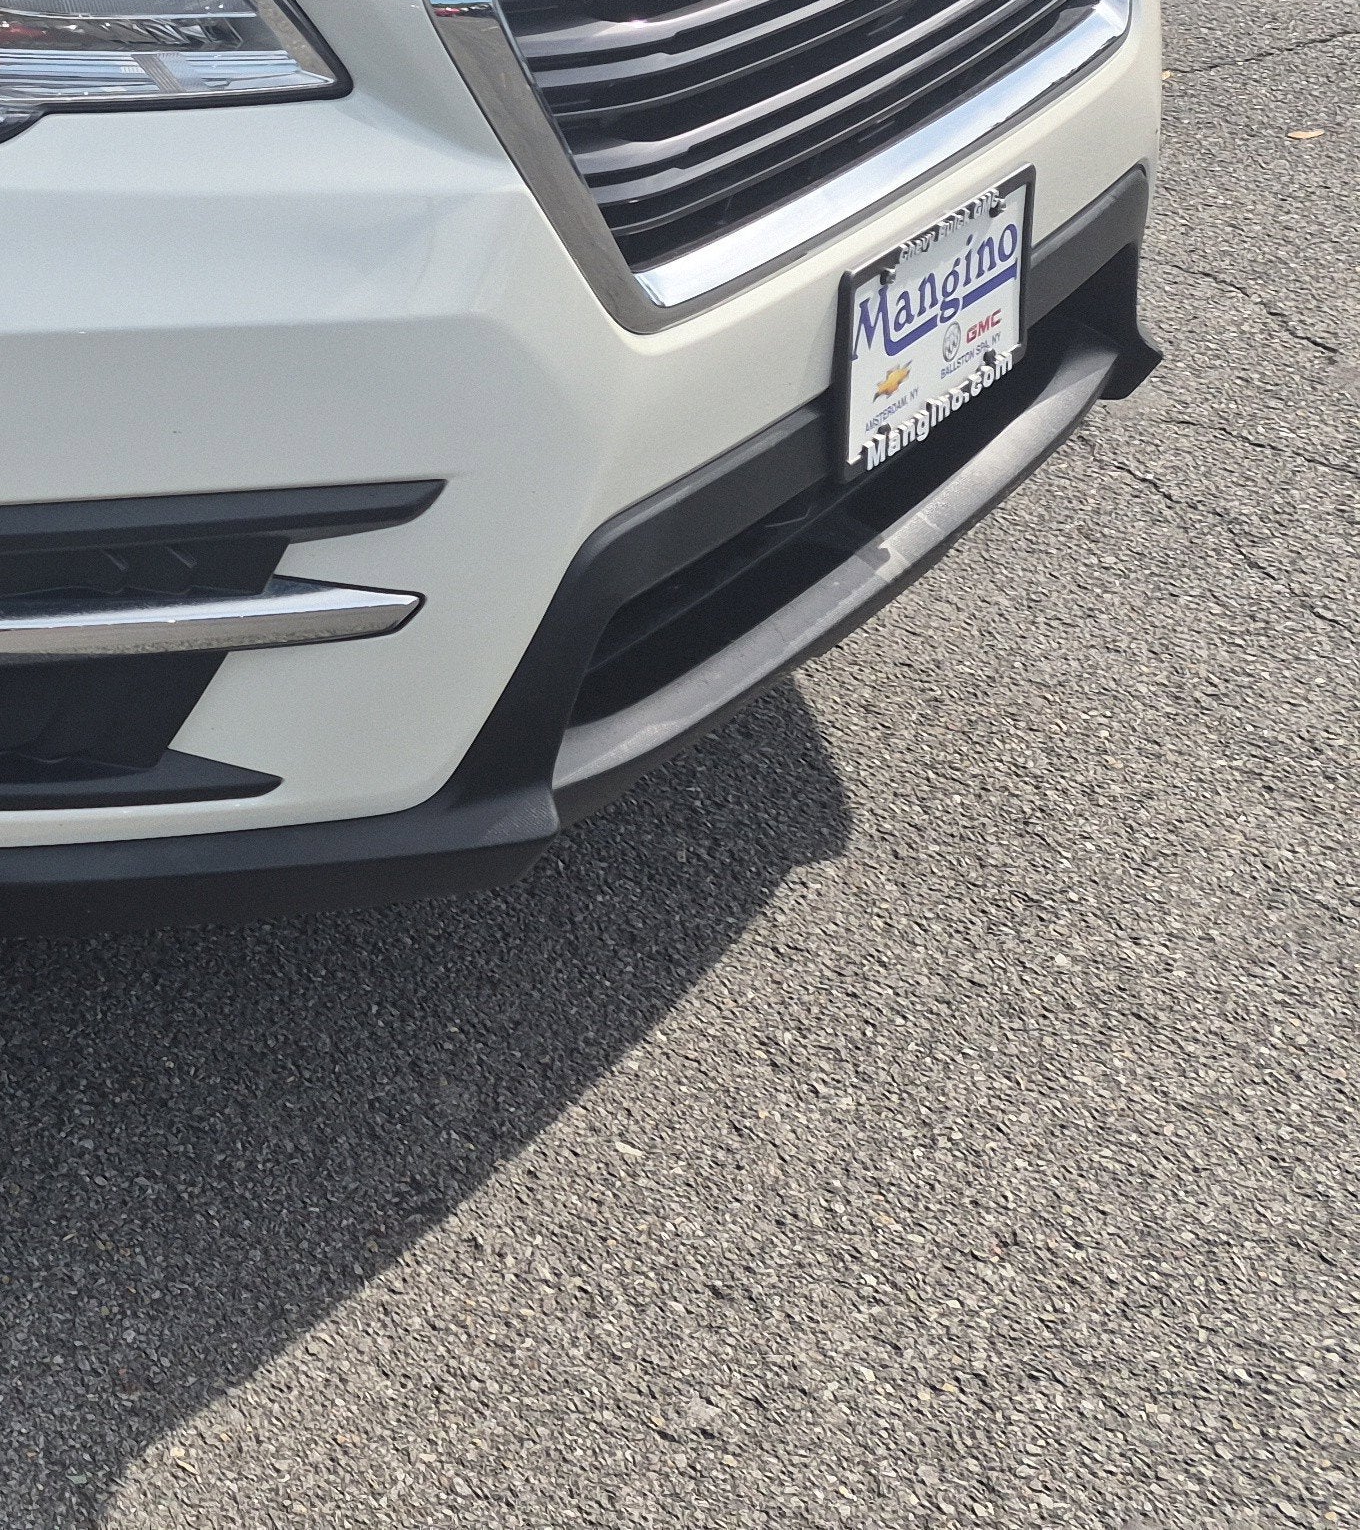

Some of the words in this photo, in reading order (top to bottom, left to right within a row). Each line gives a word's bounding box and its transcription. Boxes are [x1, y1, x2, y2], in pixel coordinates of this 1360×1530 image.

[851, 223, 1018, 361] Mangino
[966, 309, 1002, 344] GMC
[940, 350, 975, 380] BALLSTON
[991, 331, 1002, 347] NY
[866, 350, 1013, 471] Mangino.com
[910, 387, 920, 404] NY
